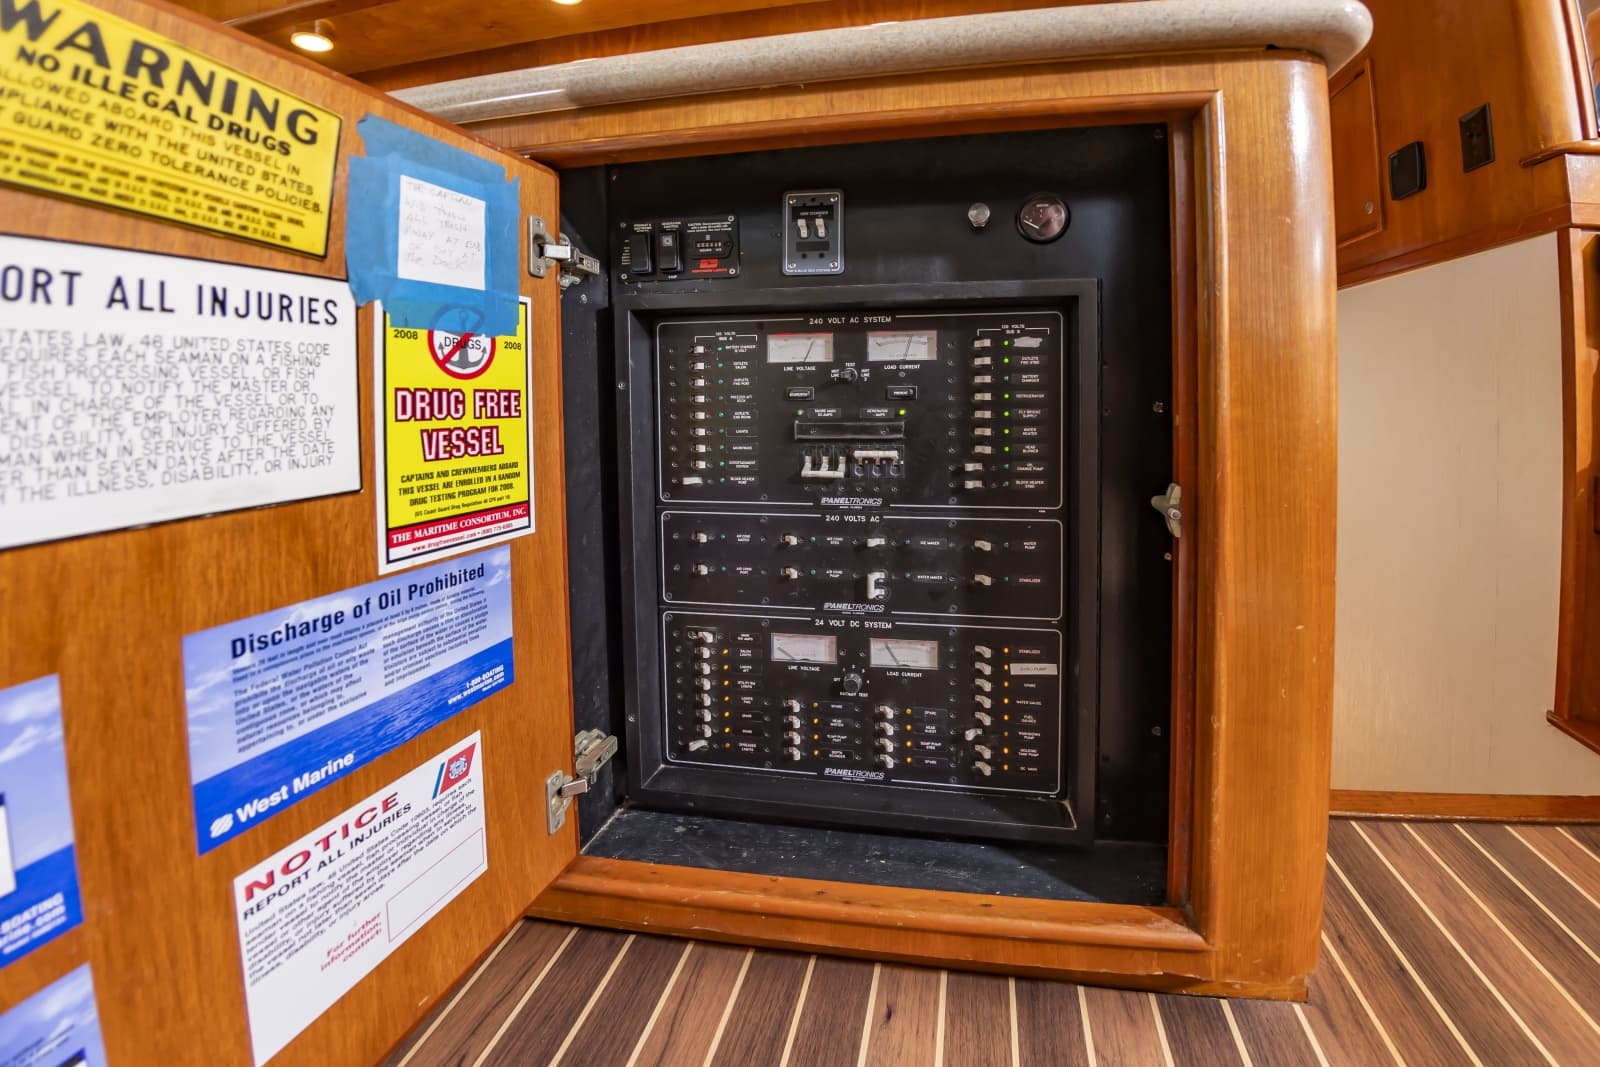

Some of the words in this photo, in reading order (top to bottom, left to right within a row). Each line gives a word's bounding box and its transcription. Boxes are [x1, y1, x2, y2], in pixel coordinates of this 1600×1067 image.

[1, 0, 318, 145] WARNING
[16, 45, 61, 73] NO
[71, 64, 198, 124] ILLEGAL
[208, 113, 291, 156] DRUGS
[13, 111, 82, 140] GUARD
[91, 133, 142, 158] ZERO
[150, 150, 249, 191] TOLERANCE
[98, 99, 174, 132] ABOARD
[181, 125, 216, 146] THIS
[224, 140, 281, 170] VESSEL
[288, 163, 301, 177] IN
[105, 119, 148, 141] WITH
[156, 135, 189, 156] THE
[197, 151, 255, 177] UNITED
[262, 170, 314, 196] STATES
[107, 276, 175, 313] ALL
[197, 284, 339, 326] INJURIES
[393, 329, 418, 340] 2008
[809, 317, 823, 325] 240
[849, 316, 859, 324] AC
[98, 348, 145, 363] EACH
[155, 350, 222, 365] SEAMAN
[271, 353, 321, 368] FISHING
[173, 336, 230, 351] UNITED
[236, 338, 292, 354] STATES
[298, 342, 331, 356] CODE
[503, 341, 521, 350] 2008
[8, 363, 55, 379] FISH
[65, 364, 179, 379] PROCESSING
[286, 367, 315, 380] FISH
[60, 396, 134, 412] CHARGE
[176, 394, 205, 408] THE
[214, 393, 272, 407] VESSEL
[88, 380, 112, 395] TO
[122, 380, 183, 395] NOTIFY
[193, 380, 221, 393] THE
[230, 380, 288, 393] MASTER
[88, 411, 123, 428] THE
[133, 407, 221, 426] EMPLOYER
[229, 406, 306, 421] REGARDING
[311, 405, 335, 417] ANY
[395, 388, 465, 422] DRUG
[474, 389, 521, 420] FREE
[171, 423, 228, 438] INJURY
[236, 419, 307, 434] SUFFERED
[314, 417, 333, 430] BY
[53, 447, 107, 463] WHEN
[143, 437, 212, 456] SERVICE
[248, 433, 274, 447] THE
[280, 430, 331, 444] VESSEL
[420, 426, 504, 462] VESSEL
[33, 465, 87, 481] THAN
[97, 457, 158, 476] SEVEN
[166, 452, 210, 470] DAYS
[217, 448, 265, 464] AFTER
[272, 444, 298, 459] THE
[303, 441, 335, 456] DATE
[400, 471, 434, 484] CAPTAINS
[436, 469, 450, 480] AND
[451, 463, 497, 477] CREWMEMBERS
[498, 461, 519, 471] ABOARD
[17, 483, 57, 502] THE
[288, 455, 333, 470] INJURY
[398, 486, 414, 497] THIS
[416, 482, 440, 494] VESSEL
[442, 480, 453, 490] ARE
[455, 476, 484, 487] ENROLLED
[498, 471, 521, 481] RANDOM
[409, 496, 428, 507] DRUG
[429, 492, 457, 504] TESTING
[457, 488, 487, 500] PROGRAM
[488, 485, 499, 495] FOR
[392, 530, 412, 545] THE
[413, 520, 459, 540] MARITIME
[459, 511, 511, 529] CONSORTIUM,
[512, 507, 527, 518] INC.
[870, 515, 880, 523] AC
[231, 610, 345, 659] Discharge
[352, 597, 371, 619] of
[378, 588, 401, 610] Oil
[408, 563, 485, 601] Prohibited
[864, 621, 892, 629] SYSTEM
[236, 785, 289, 823] West
[293, 753, 355, 794] Marine
[243, 868, 311, 920] REPORT
[317, 849, 345, 872] ALL
[350, 803, 412, 849] INJURIES
[244, 792, 398, 902] NOTICE
[347, 912, 381, 941] further
